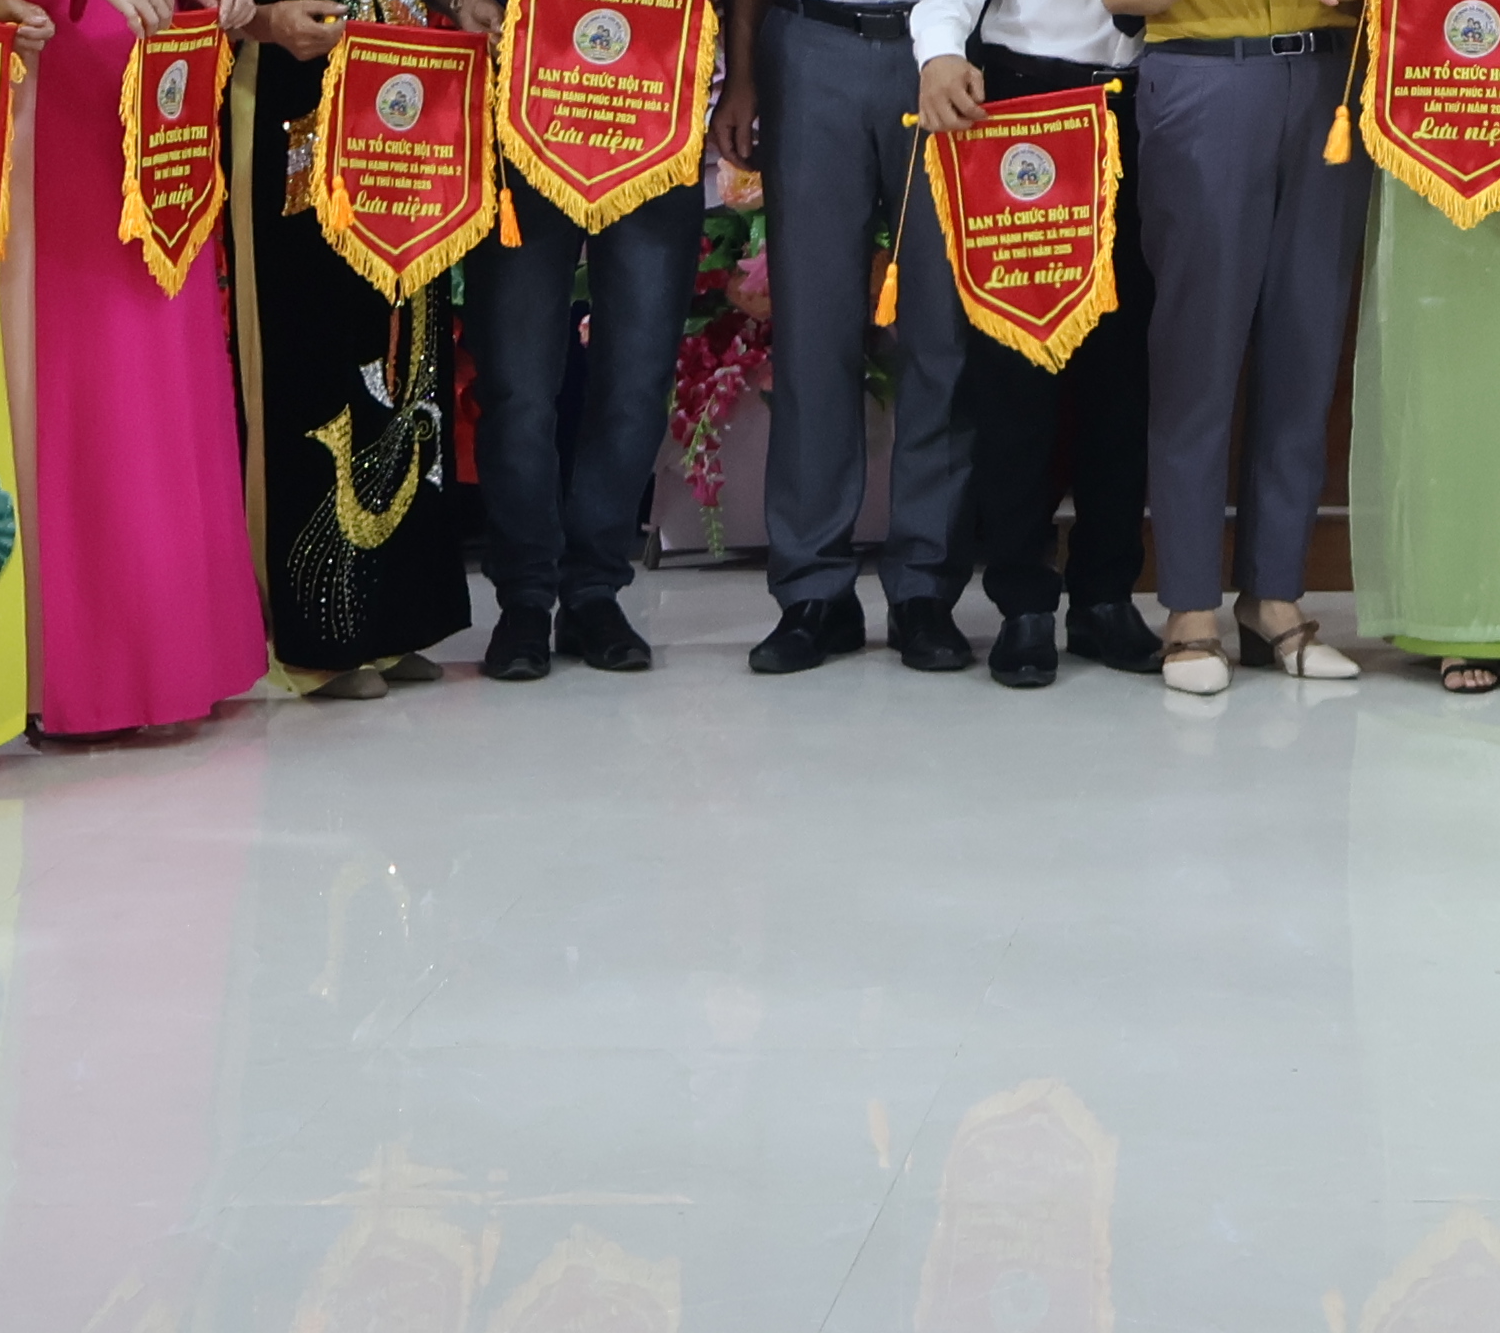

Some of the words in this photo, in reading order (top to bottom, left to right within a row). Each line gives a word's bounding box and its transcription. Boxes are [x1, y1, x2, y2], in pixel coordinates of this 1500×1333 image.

[563, 65, 580, 84] TỔ
[582, 72, 616, 89] CHỨC
[618, 75, 639, 94] HỘI
[642, 80, 663, 94] THI
[1404, 66, 1431, 79] BAN
[1434, 60, 1450, 79] TỔ
[1453, 64, 1488, 80] CHỨC
[1412, 117, 1459, 139] Lưu
[589, 128, 645, 154] niệm
